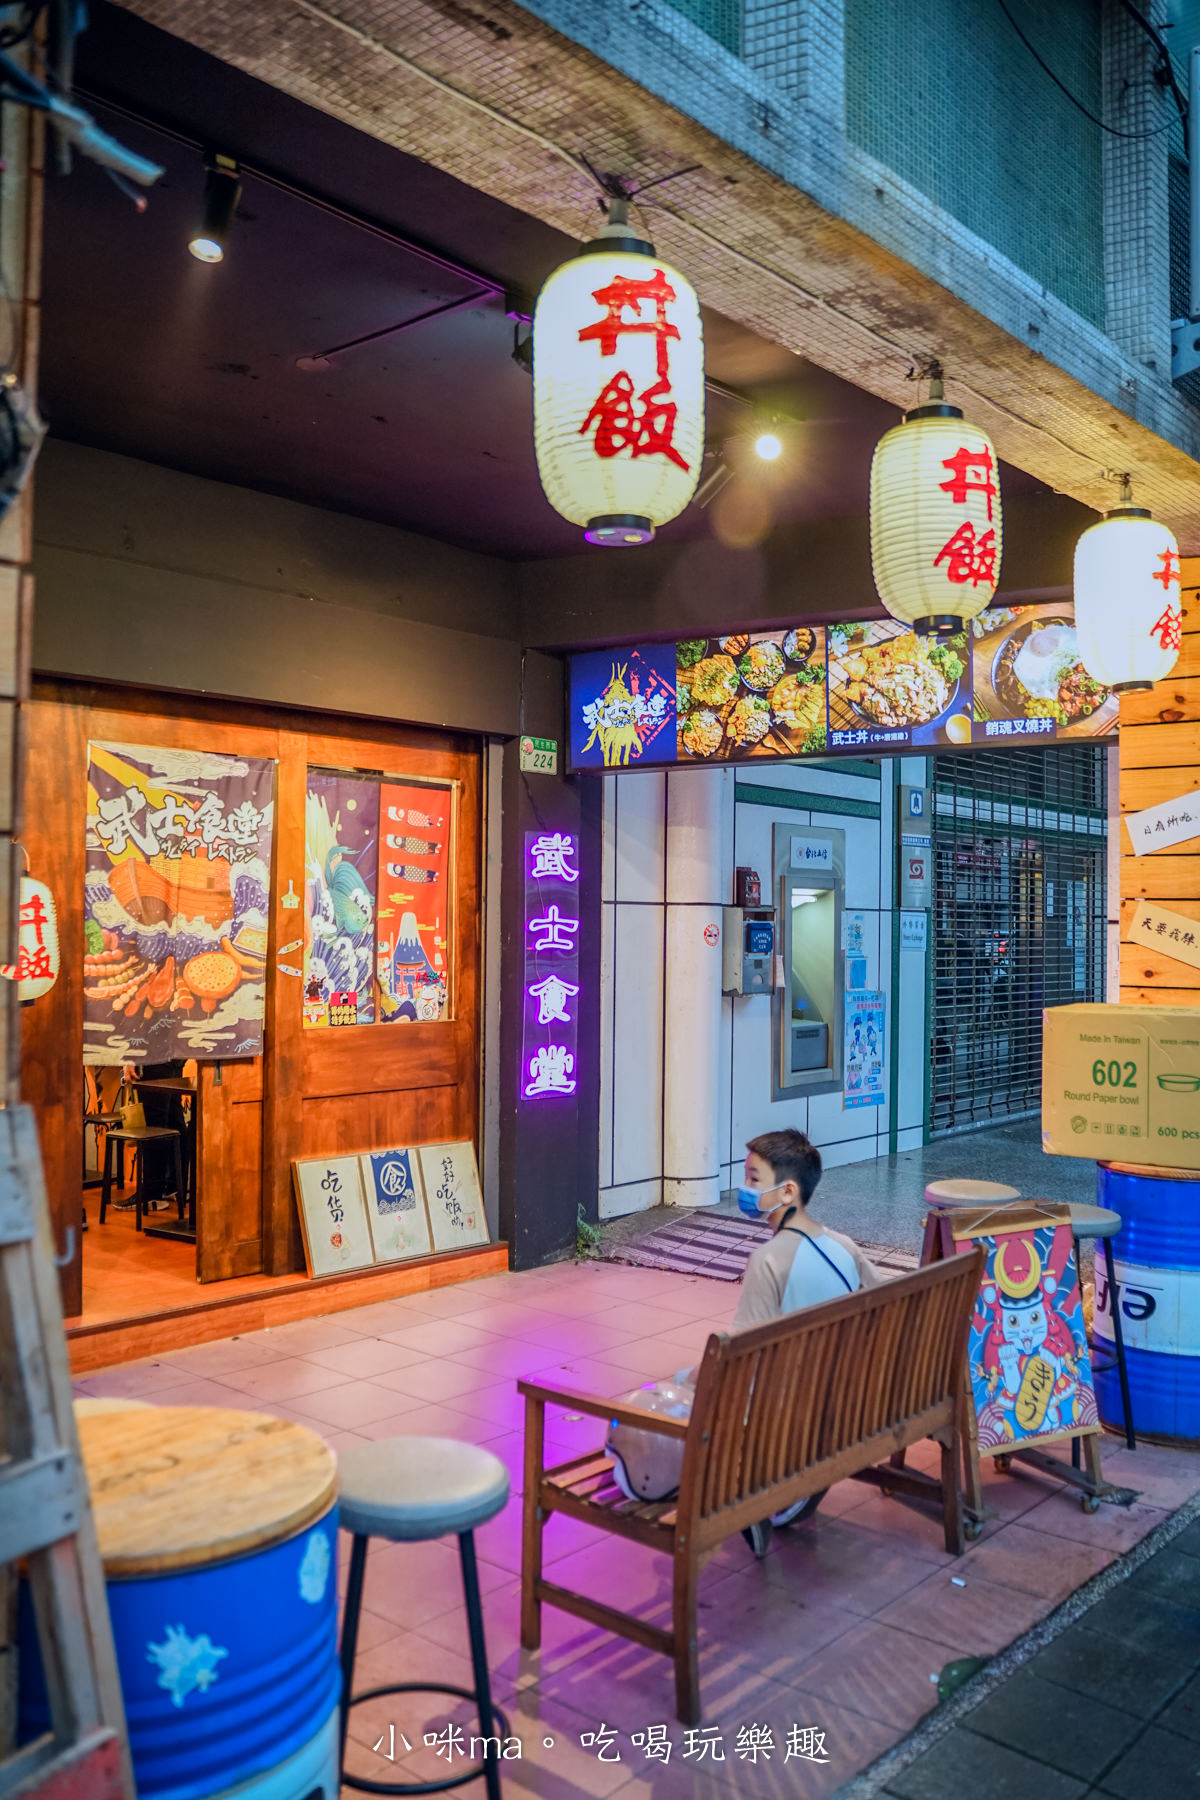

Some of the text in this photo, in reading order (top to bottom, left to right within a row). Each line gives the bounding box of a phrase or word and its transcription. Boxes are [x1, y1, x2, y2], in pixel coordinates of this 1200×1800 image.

[578, 269, 689, 472] 丼飯
[934, 443, 997, 592] 丼飯
[985, 718, 1053, 736] 銷魂叉燒丼
[832, 730, 868, 745] 武士丼
[534, 754, 553, 768] 224
[96, 786, 264, 856] 武士食堂
[207, 843, 257, 865] レストラン
[525, 832, 579, 1096] 武士食堂
[1079, 1034, 1101, 1042] Made
[1113, 1036, 1141, 1044] Taiwan
[1092, 1059, 1137, 1088] 602
[1064, 1090, 1139, 1105] Round Paper bowl
[1158, 1127, 1178, 1137] 600
